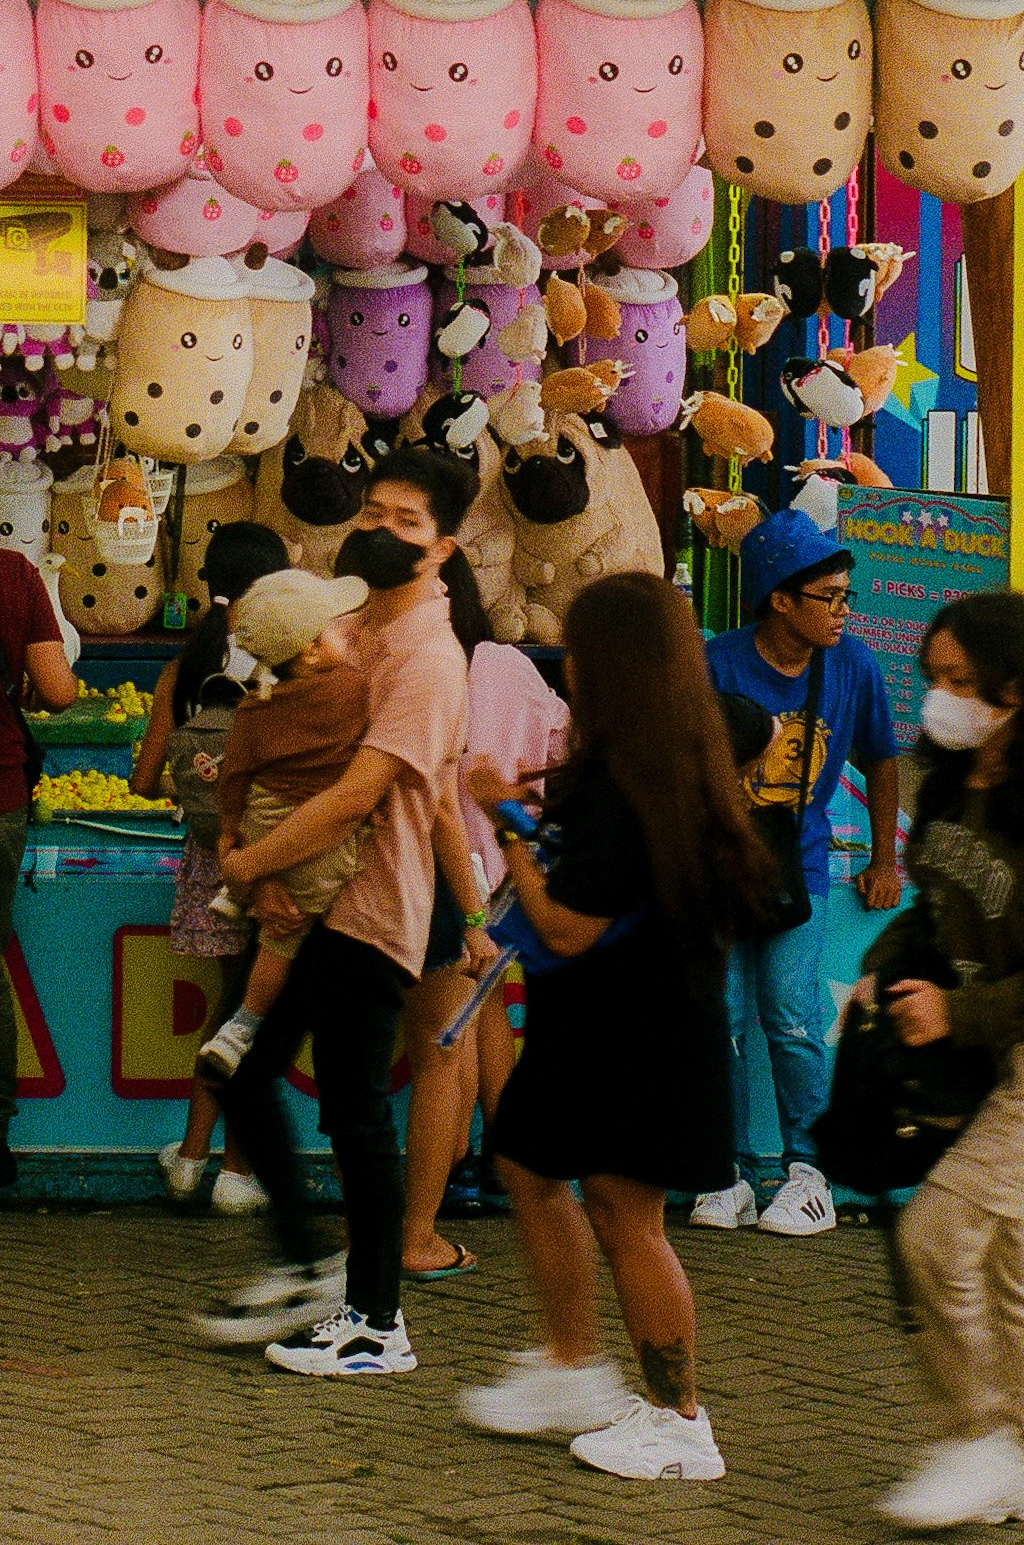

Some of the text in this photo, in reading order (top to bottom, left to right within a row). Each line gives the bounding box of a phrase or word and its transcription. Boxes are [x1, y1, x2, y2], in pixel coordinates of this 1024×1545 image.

[845, 518, 1007, 559] HOOK A DUCK
[872, 579, 882, 593] 5
[886, 581, 926, 600] PICKS
